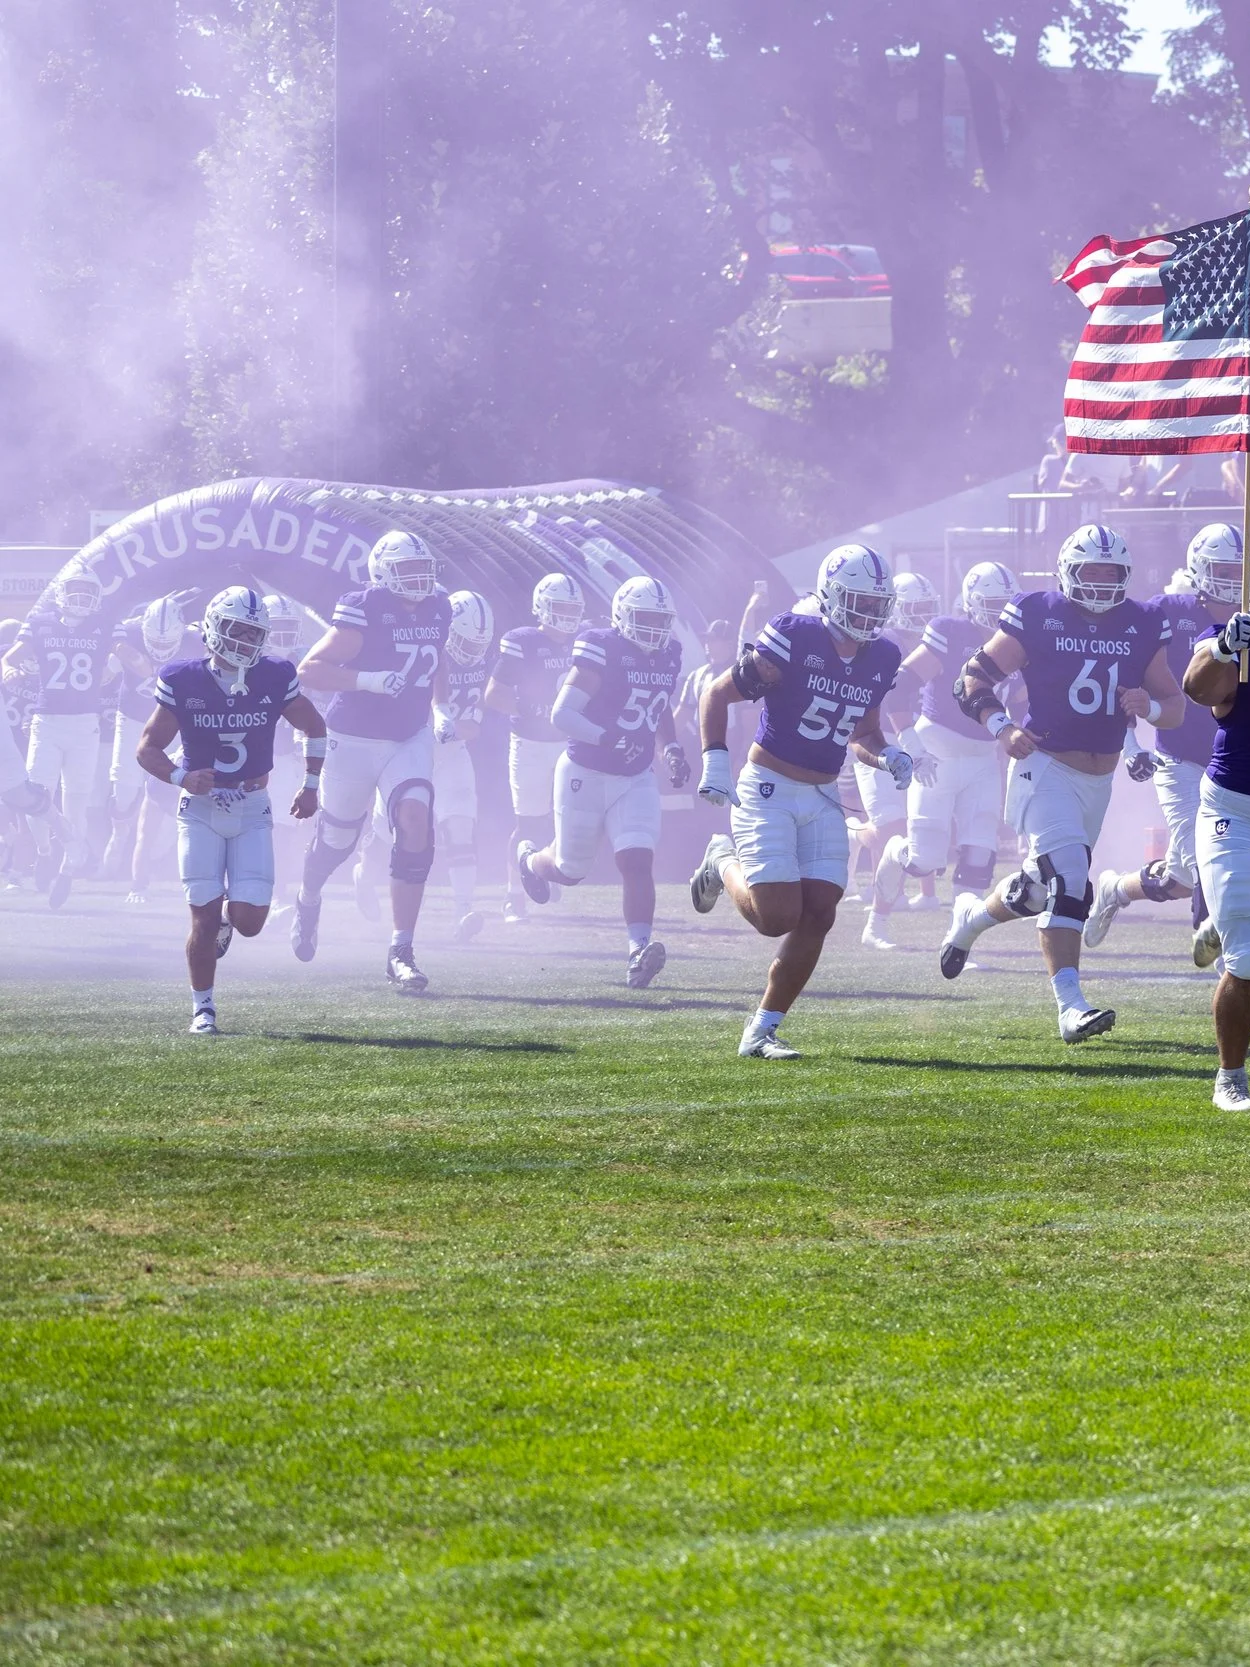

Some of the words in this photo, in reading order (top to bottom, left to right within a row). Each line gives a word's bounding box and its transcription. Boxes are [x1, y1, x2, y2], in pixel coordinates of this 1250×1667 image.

[44, 637, 66, 649] HOLY
[67, 638, 98, 650] CROSS
[392, 627, 414, 641] HOLY
[415, 626, 440, 640] CROSS
[1055, 636, 1088, 653] HOLY
[1090, 640, 1131, 656] CROSS
[45, 651, 93, 691] 28
[395, 643, 439, 688] 72
[544, 658, 565, 669] HOLY
[627, 671, 649, 684] HOLY
[650, 672, 673, 686] CROSS
[807, 674, 839, 696] HOLY
[840, 683, 873, 705] CROSS
[1068, 659, 1119, 716] 61
[193, 713, 225, 728] HOLY
[227, 711, 268, 728] CROSS
[797, 695, 866, 747] 55
[213, 732, 248, 773] 3
